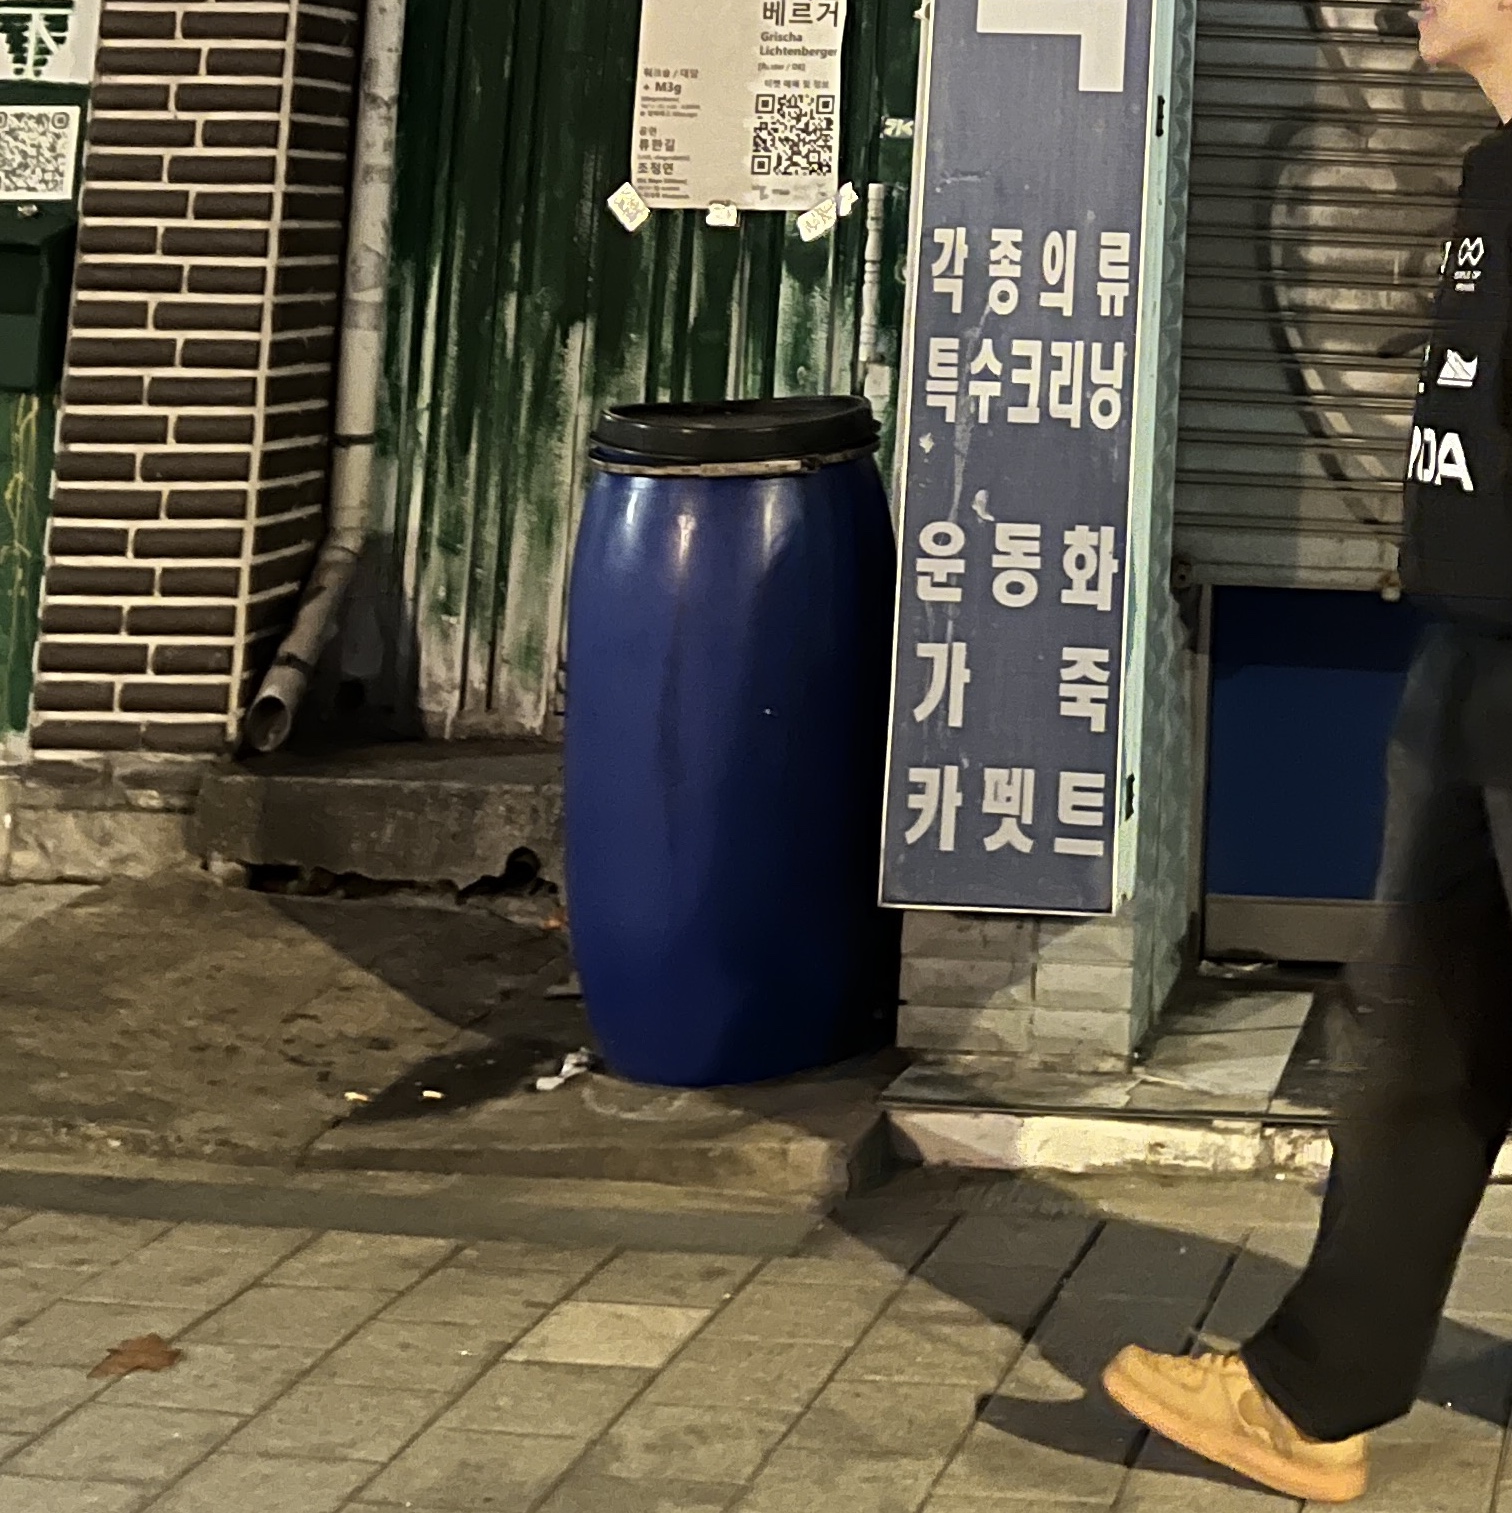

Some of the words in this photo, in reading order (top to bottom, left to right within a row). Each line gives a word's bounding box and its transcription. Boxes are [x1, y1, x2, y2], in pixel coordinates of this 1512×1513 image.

[760, 31, 803, 42] Grischa
[762, 0, 839, 27] 베르거
[759, 45, 838, 59] Lichtenberger
[925, 336, 1125, 430] 특수크리닝
[915, 519, 1119, 612] 운동화
[904, 765, 1105, 857] 카펫트
